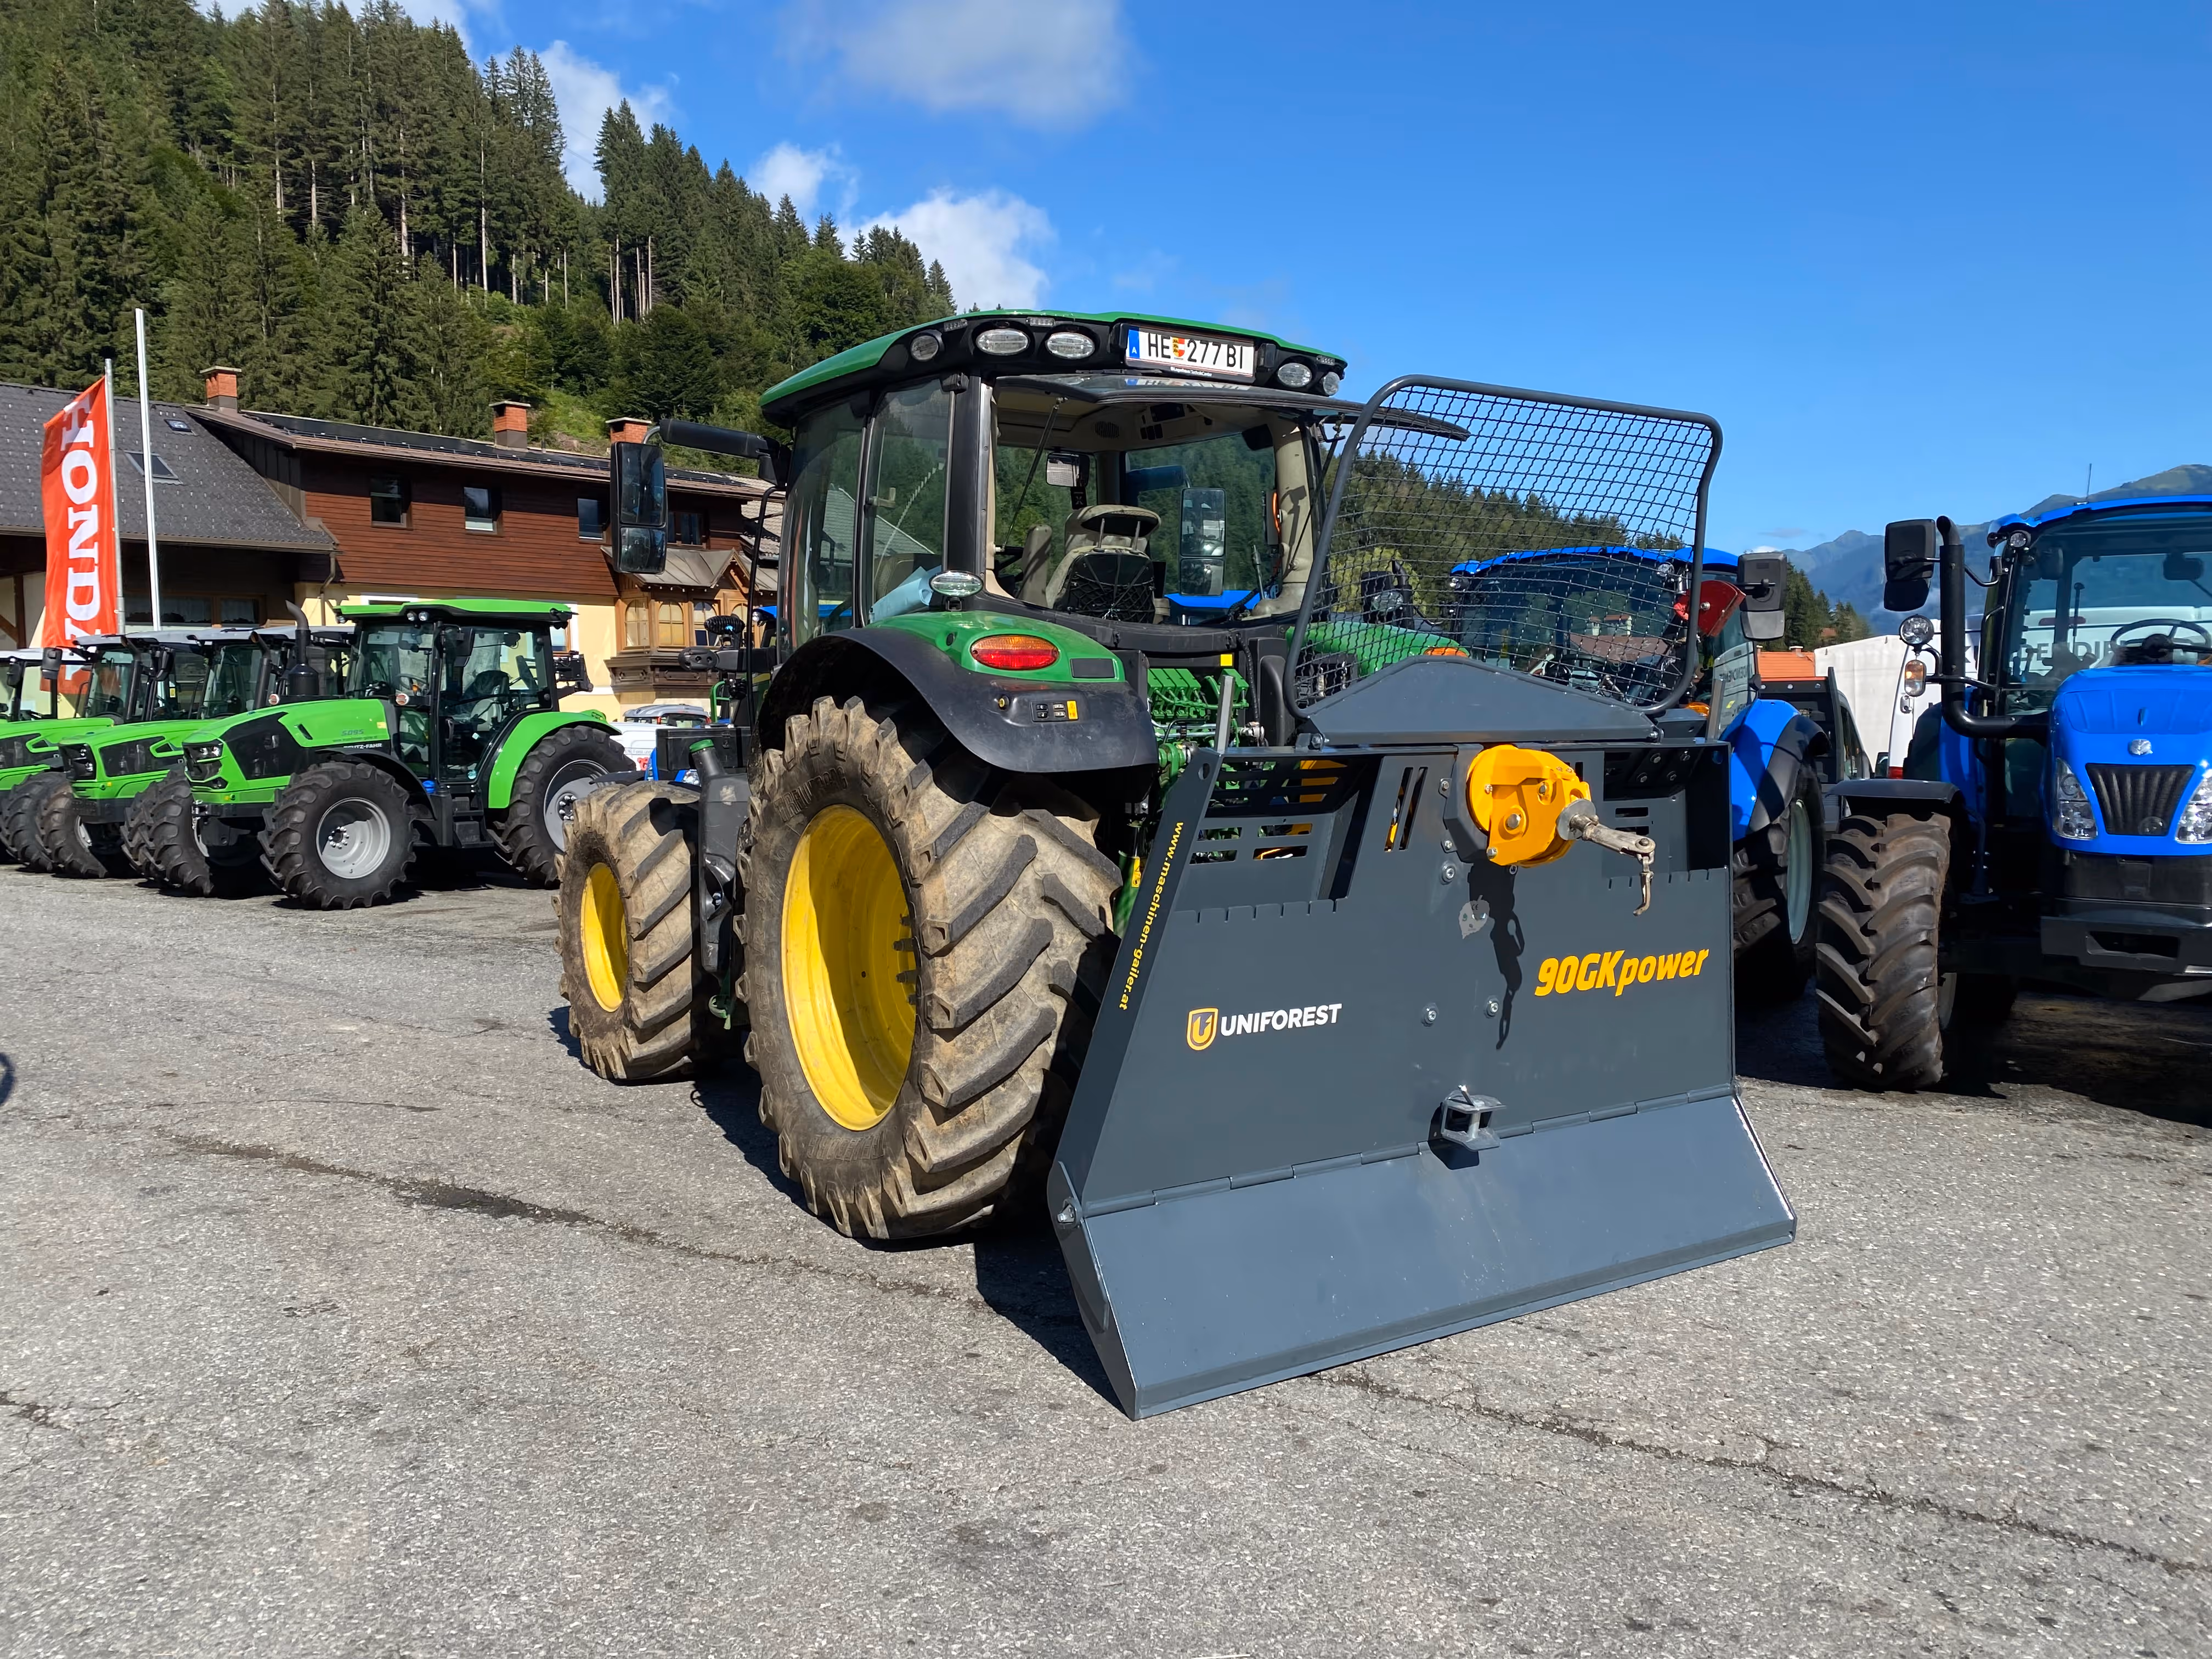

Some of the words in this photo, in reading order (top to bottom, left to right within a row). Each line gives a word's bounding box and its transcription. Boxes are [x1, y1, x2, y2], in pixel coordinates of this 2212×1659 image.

[1148, 332, 1171, 359] HE
[1119, 821, 1184, 1011] www.maschinen-gailer.at
[1221, 1003, 1342, 1036] UNIFOREST
